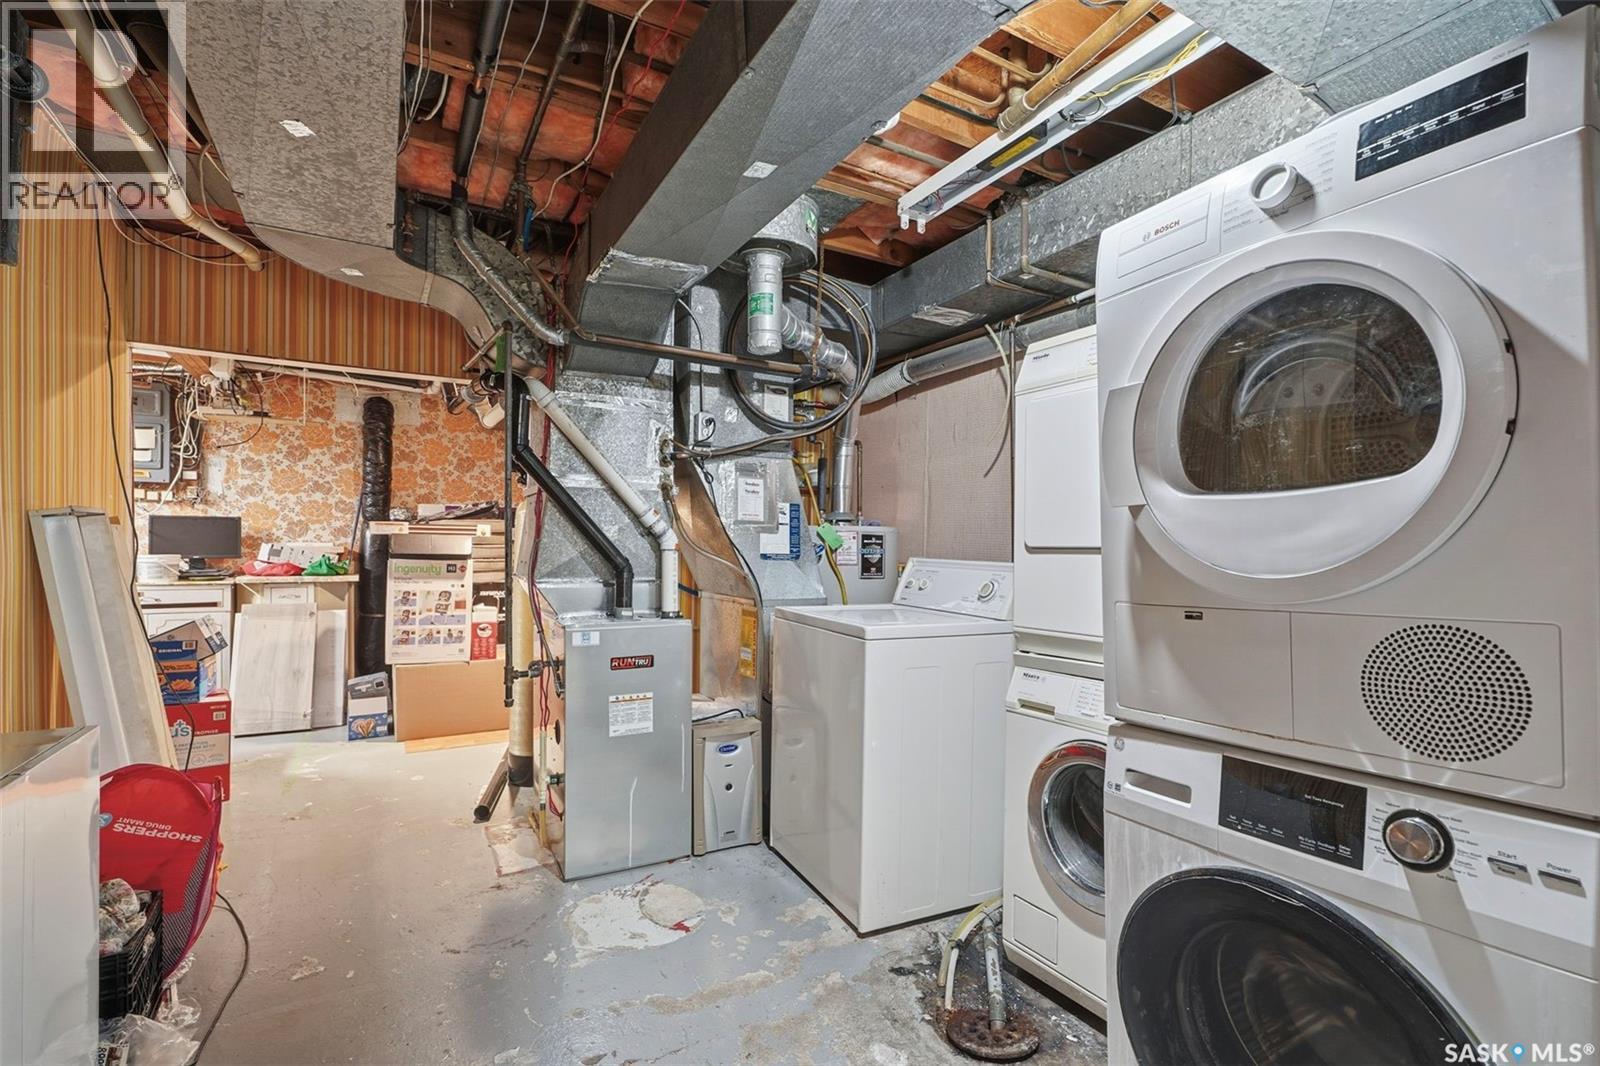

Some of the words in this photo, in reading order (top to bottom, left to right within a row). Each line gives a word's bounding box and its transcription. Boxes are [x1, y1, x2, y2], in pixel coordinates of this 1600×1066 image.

[1154, 219, 1181, 236] BOSCH
[117, 817, 145, 826] MART
[146, 821, 172, 831] DRUG
[112, 822, 203, 843] SHOPPERS
[1497, 850, 1518, 860] Start
[1546, 862, 1573, 874] Power
